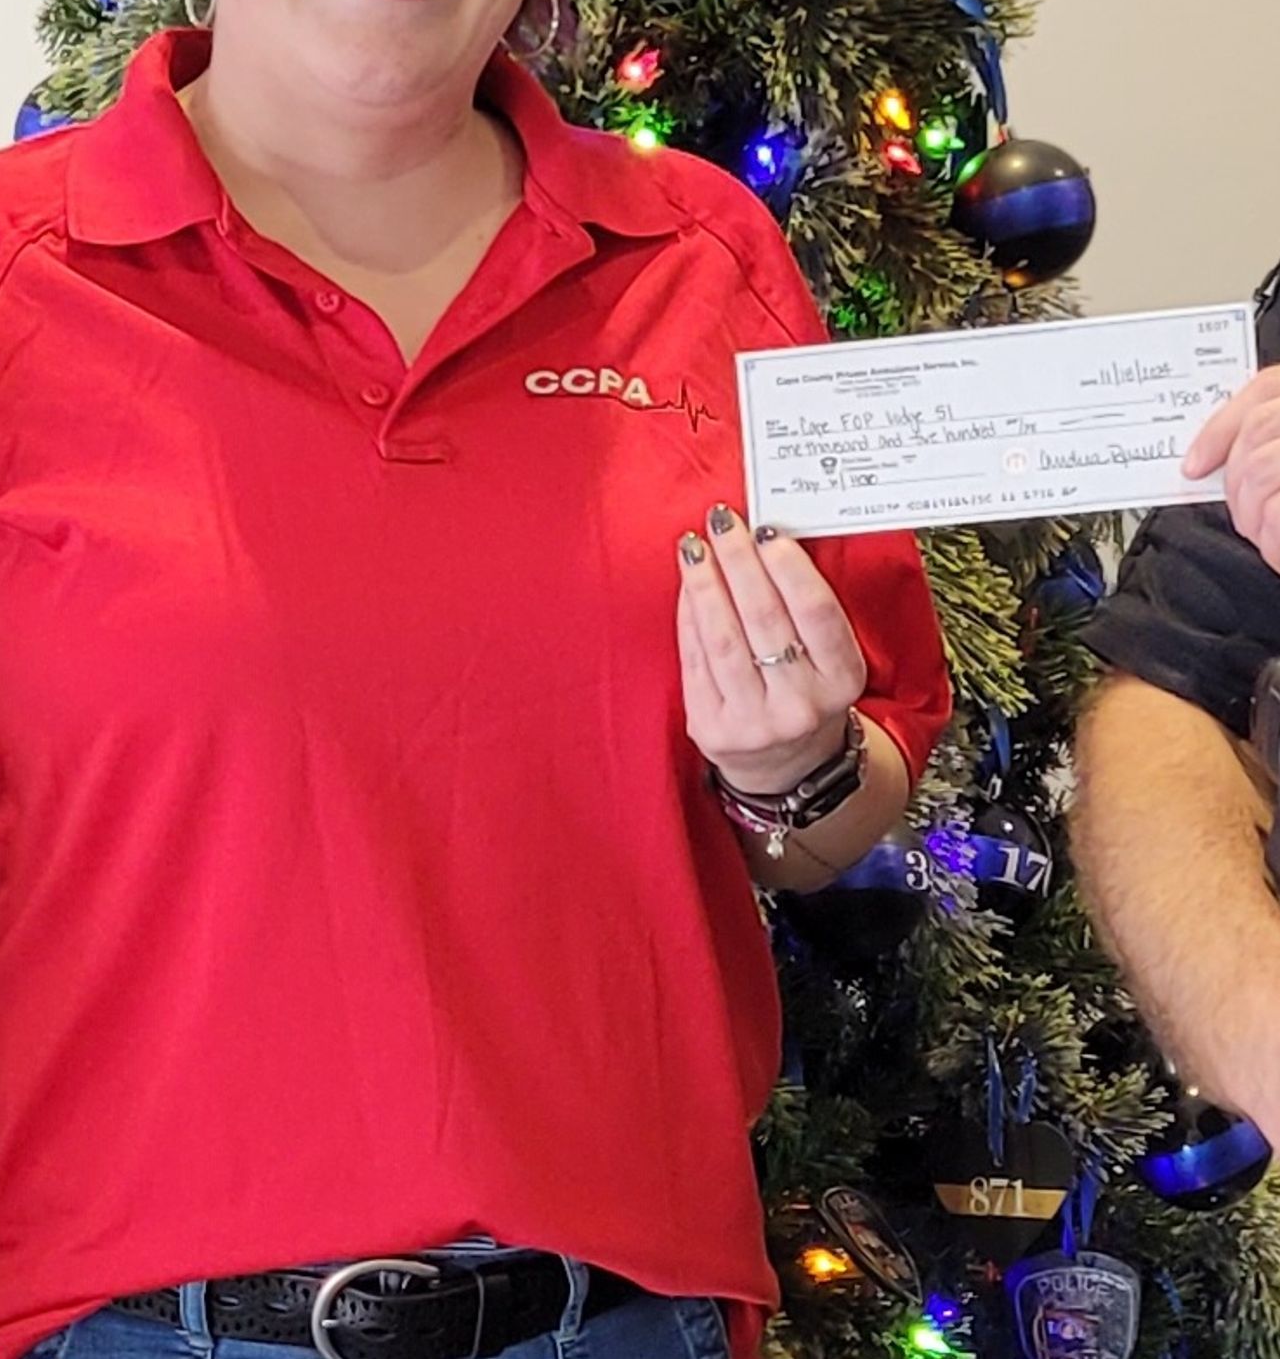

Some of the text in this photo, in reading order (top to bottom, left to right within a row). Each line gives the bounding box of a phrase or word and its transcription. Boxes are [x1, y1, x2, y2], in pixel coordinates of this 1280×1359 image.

[525, 368, 654, 407] CCPA
[840, 412, 874, 432] FOP
[969, 1176, 1025, 1217] 871
[1036, 1272, 1111, 1295] POLICE
